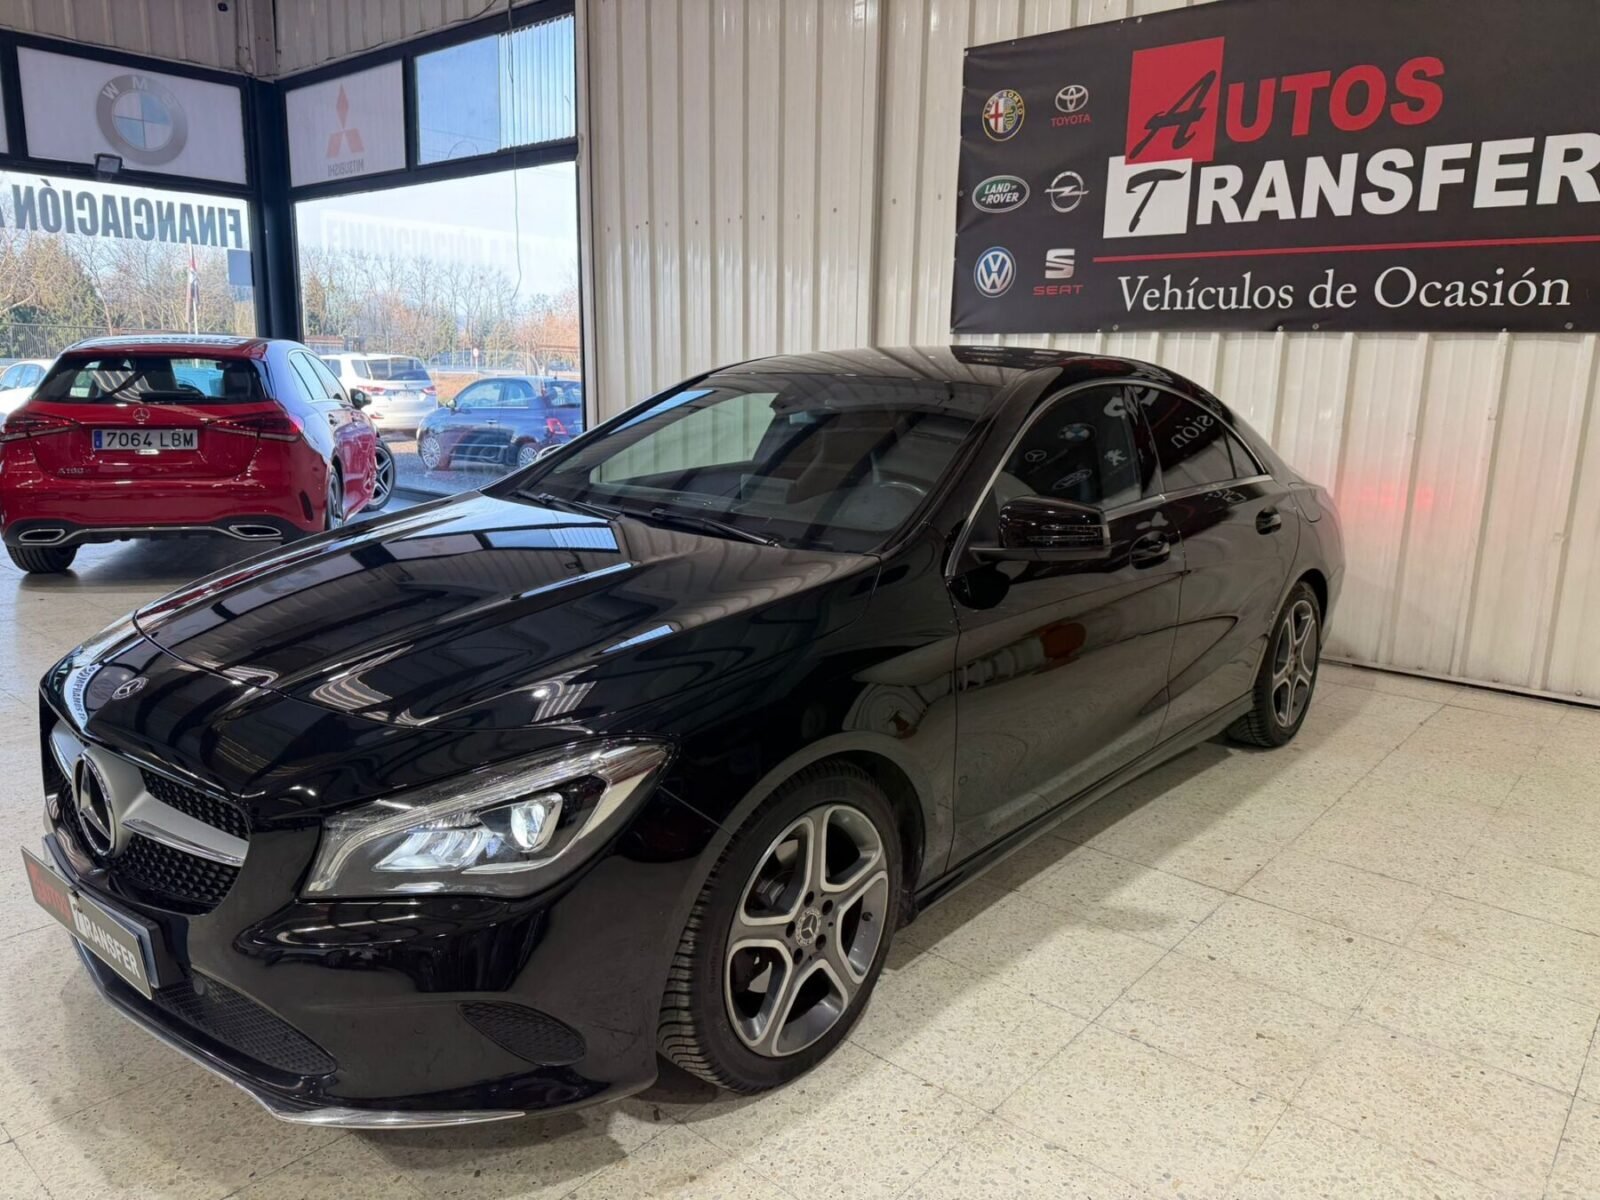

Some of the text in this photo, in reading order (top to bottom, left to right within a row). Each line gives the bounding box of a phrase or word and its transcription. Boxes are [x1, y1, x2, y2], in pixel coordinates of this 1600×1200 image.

[1128, 55, 1446, 160] AUTOS
[1051, 114, 1092, 127] TOYOTA
[985, 183, 1011, 195] LAND
[1125, 132, 1600, 233] TRANSFER
[985, 192, 1020, 205] ROVER
[1033, 284, 1084, 296] SEAT
[1118, 266, 1571, 312] Vehículos de Ocasión
[107, 432, 194, 447] 7064 LBM
